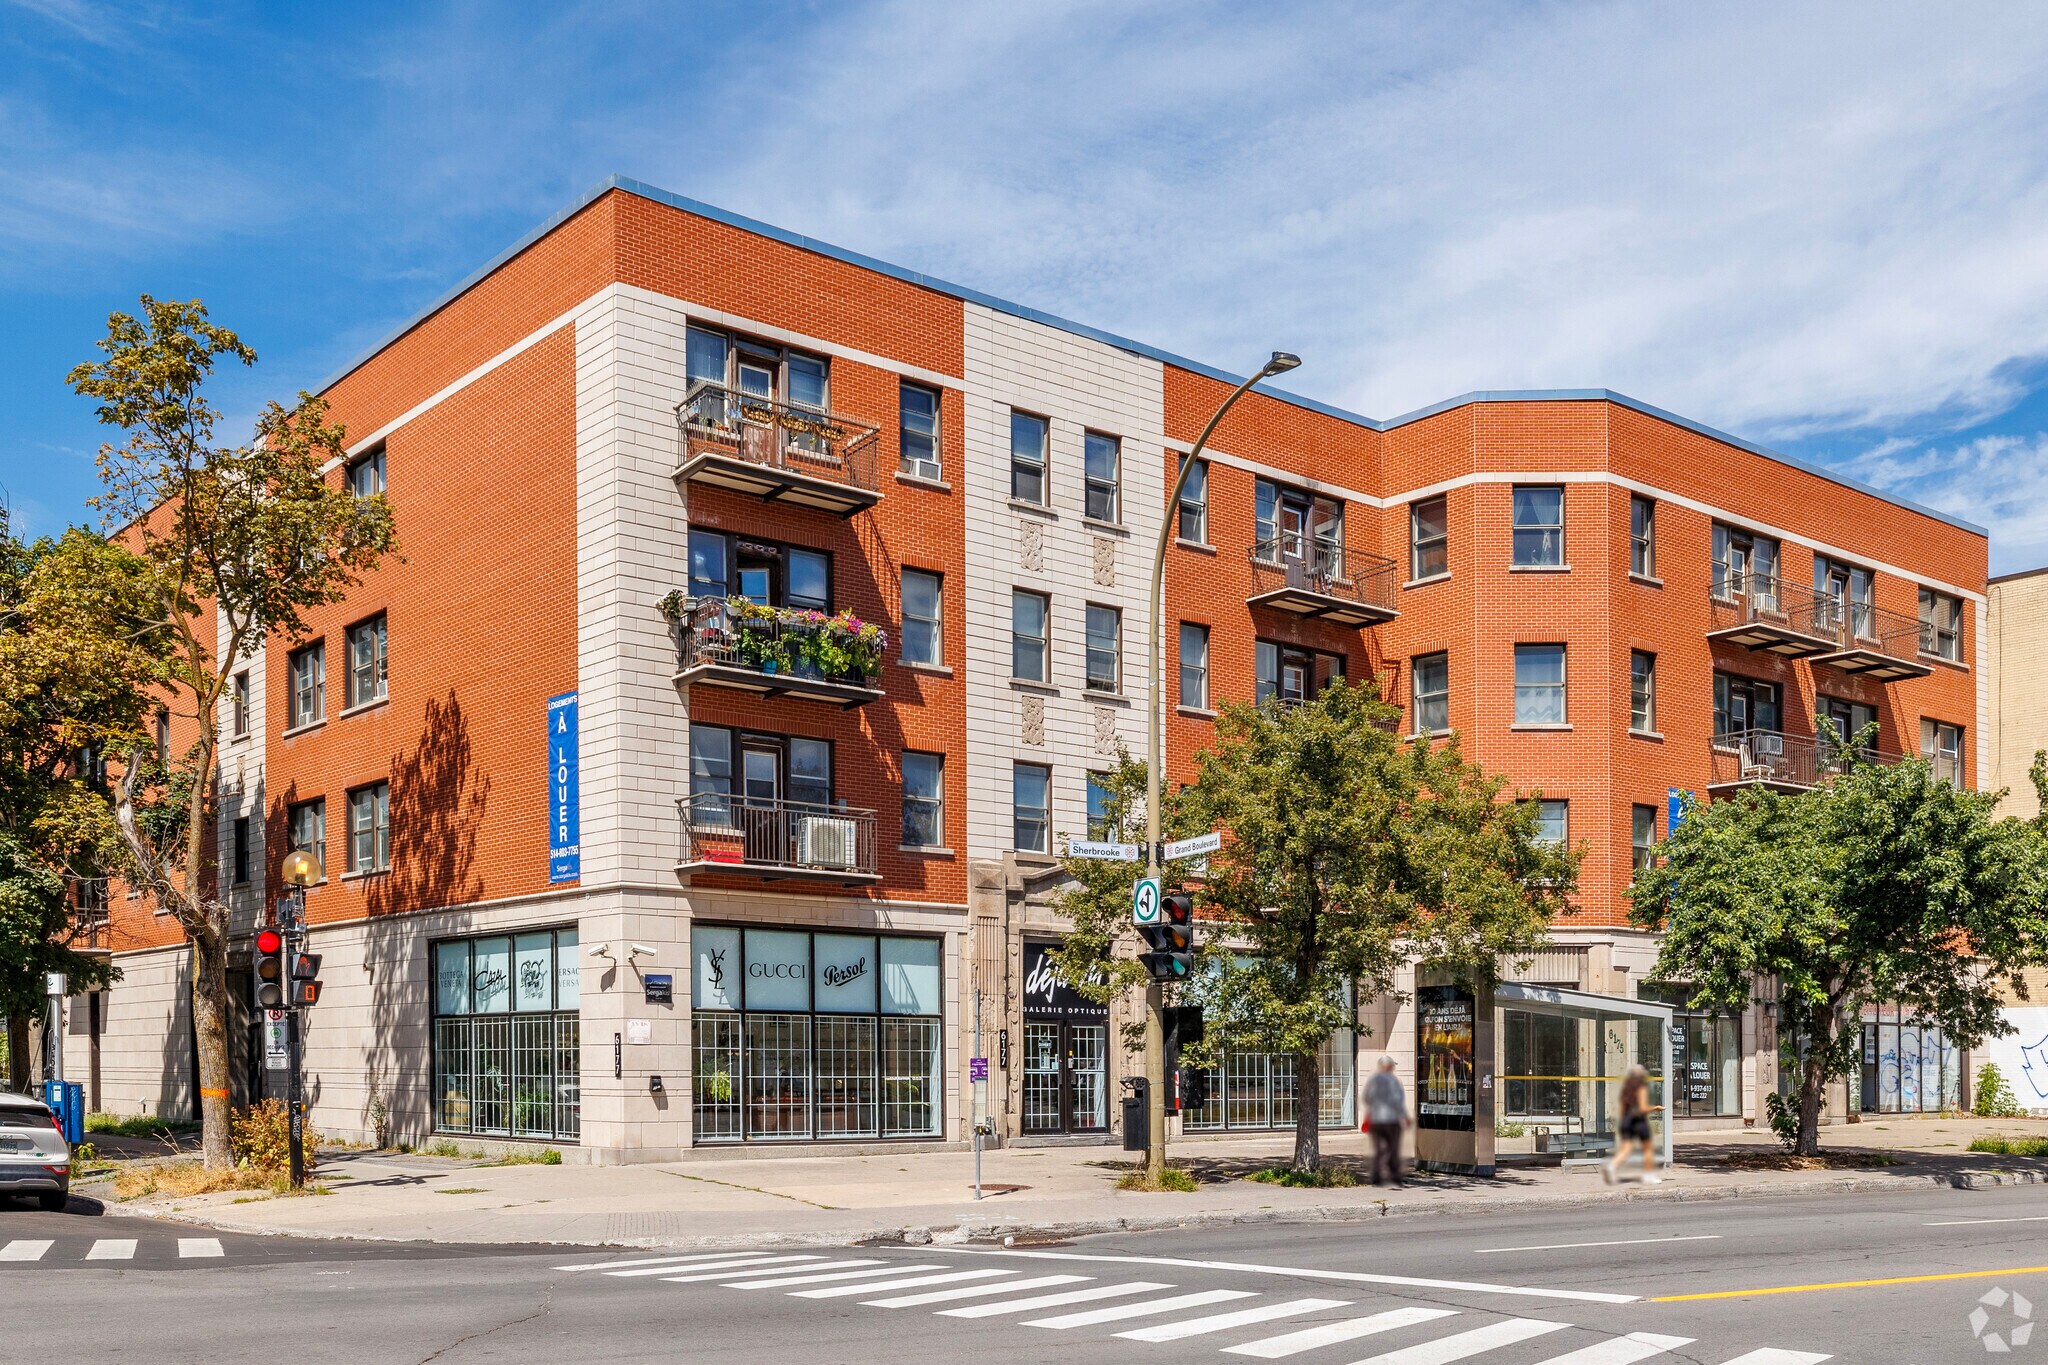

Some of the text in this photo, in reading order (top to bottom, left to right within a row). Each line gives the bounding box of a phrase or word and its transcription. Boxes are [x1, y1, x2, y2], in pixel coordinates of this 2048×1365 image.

[548, 696, 577, 710] LOGEMENTS
[558, 712, 568, 842] À LOUER
[1072, 846, 1120, 857] Sherbrooke
[1174, 838, 1218, 855] Grand Boulevard
[557, 968, 580, 976] ERSAC
[749, 963, 806, 979] GUCCI
[824, 957, 868, 987] Persol
[1450, 1005, 1466, 1014] DÉJÀ
[1608, 1028, 1625, 1054] 6175
[1690, 1062, 1708, 1070] SPACE
